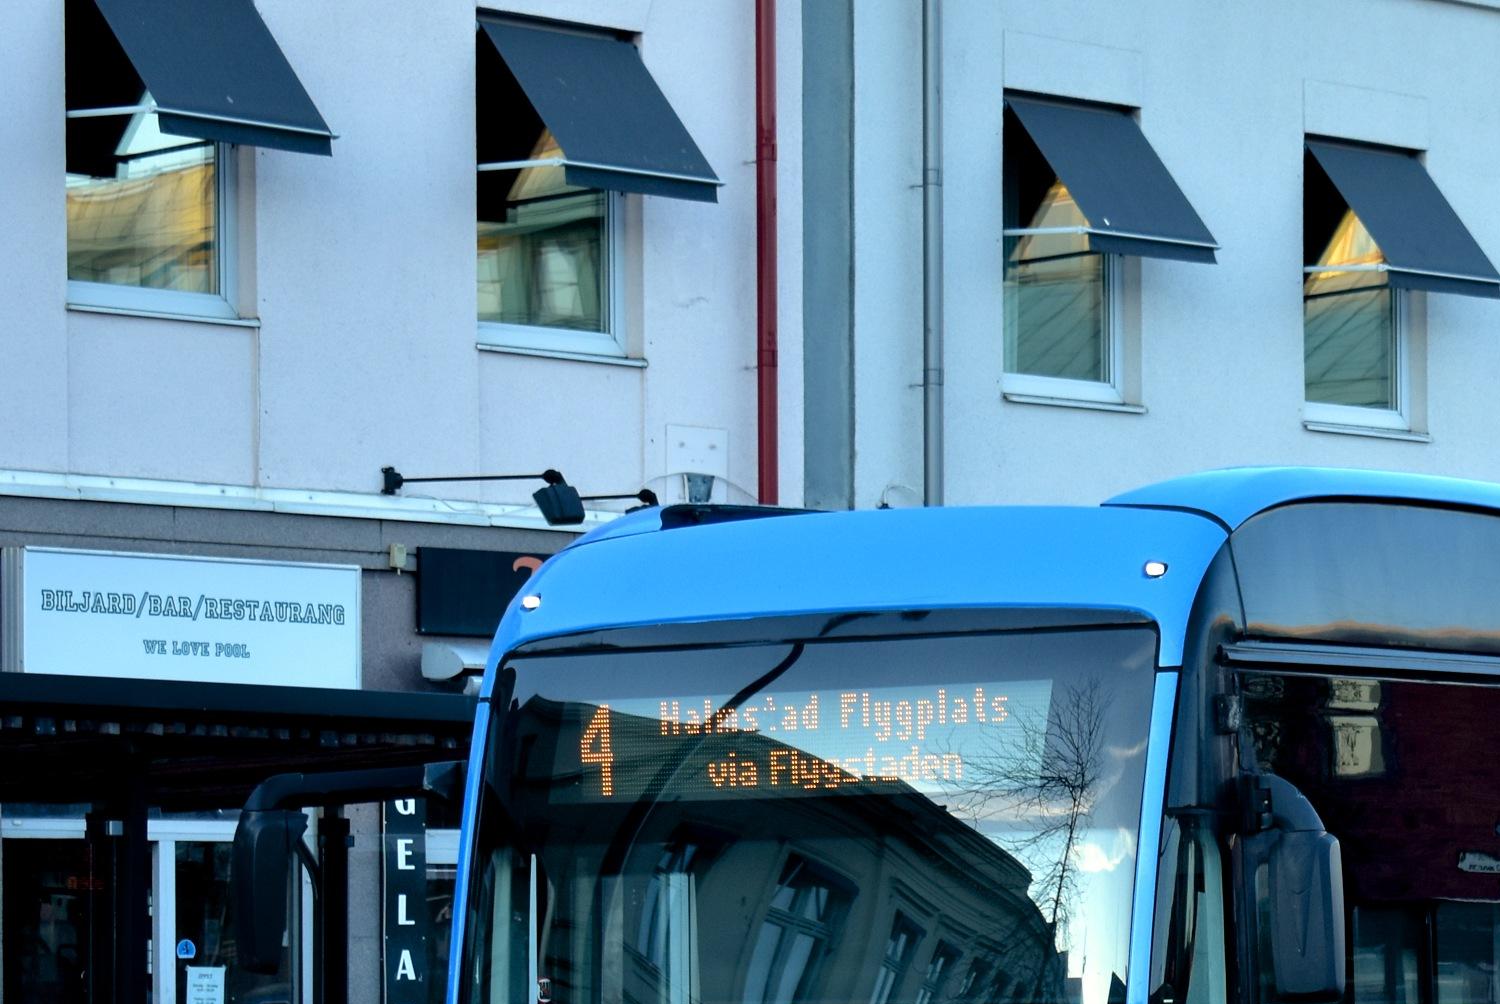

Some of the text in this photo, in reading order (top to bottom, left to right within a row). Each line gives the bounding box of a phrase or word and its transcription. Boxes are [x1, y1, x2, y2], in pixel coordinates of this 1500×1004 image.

[41, 589, 345, 625] BILJARD/BAR/RESTAURANG
[143, 640, 250, 658] WE LOVE POOL
[841, 687, 1008, 742] Flygplats
[580, 704, 613, 796] 4
[708, 745, 962, 789] via Flygstaden
